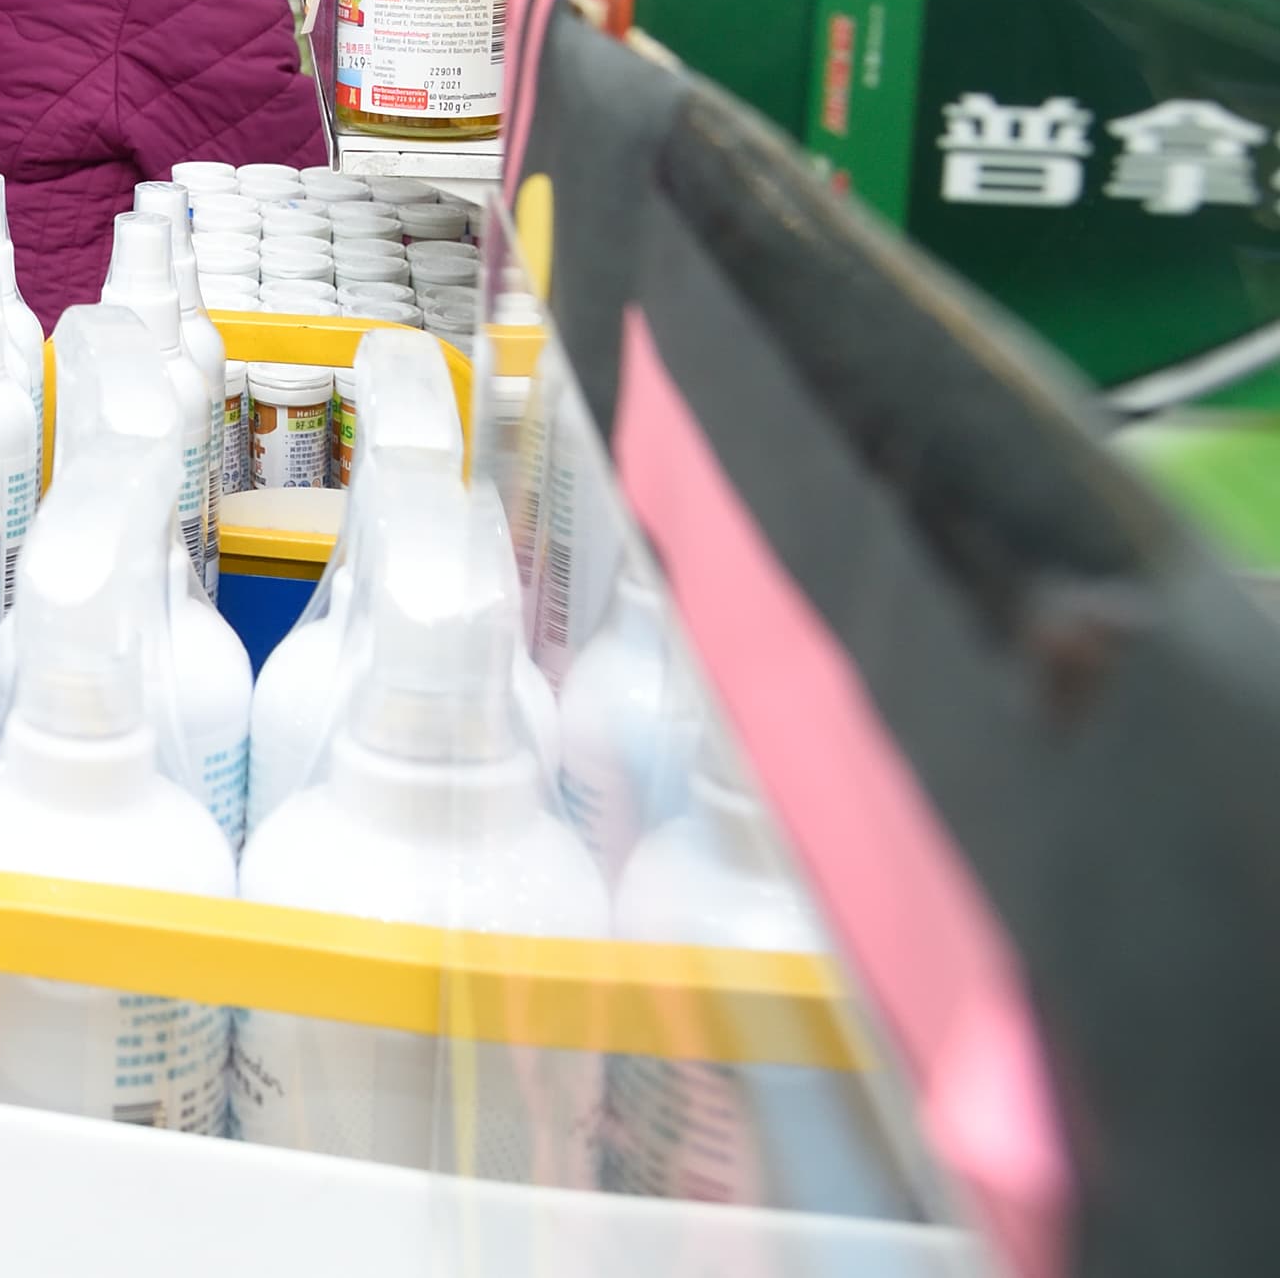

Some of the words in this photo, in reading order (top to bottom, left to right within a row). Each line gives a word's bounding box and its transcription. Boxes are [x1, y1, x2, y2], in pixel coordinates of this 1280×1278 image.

[429, 67, 462, 76] 229018
[440, 81, 461, 90] 2021
[439, 102, 454, 111] 120
[934, 90, 1280, 217] 普拿
